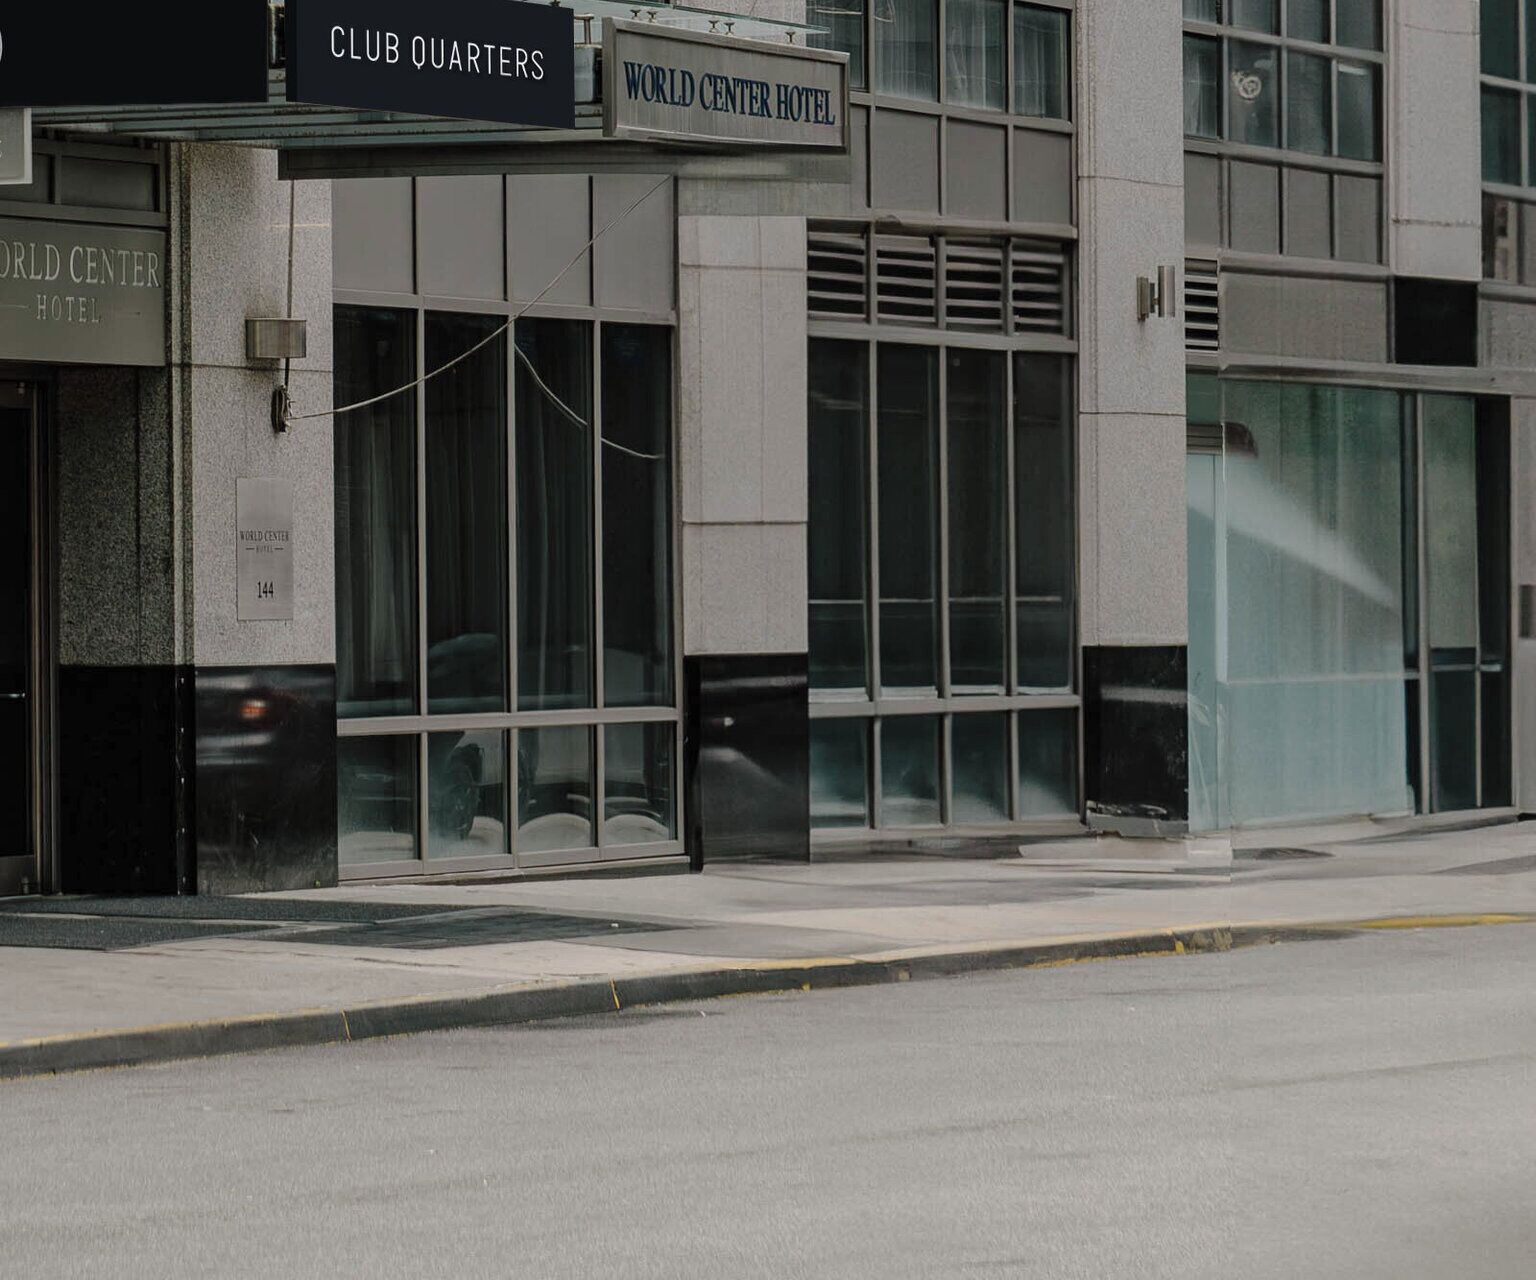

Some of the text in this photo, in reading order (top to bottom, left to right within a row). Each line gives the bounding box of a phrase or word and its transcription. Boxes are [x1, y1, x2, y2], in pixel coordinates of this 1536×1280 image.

[330, 25, 545, 80] CLUB QUARTERS
[623, 60, 836, 126] WORLD CENTER HOTEL
[69, 245, 162, 288] CENTER
[36, 294, 101, 323] HOTEL
[240, 529, 290, 542] WORLD CENTER
[257, 581, 274, 599] 144
